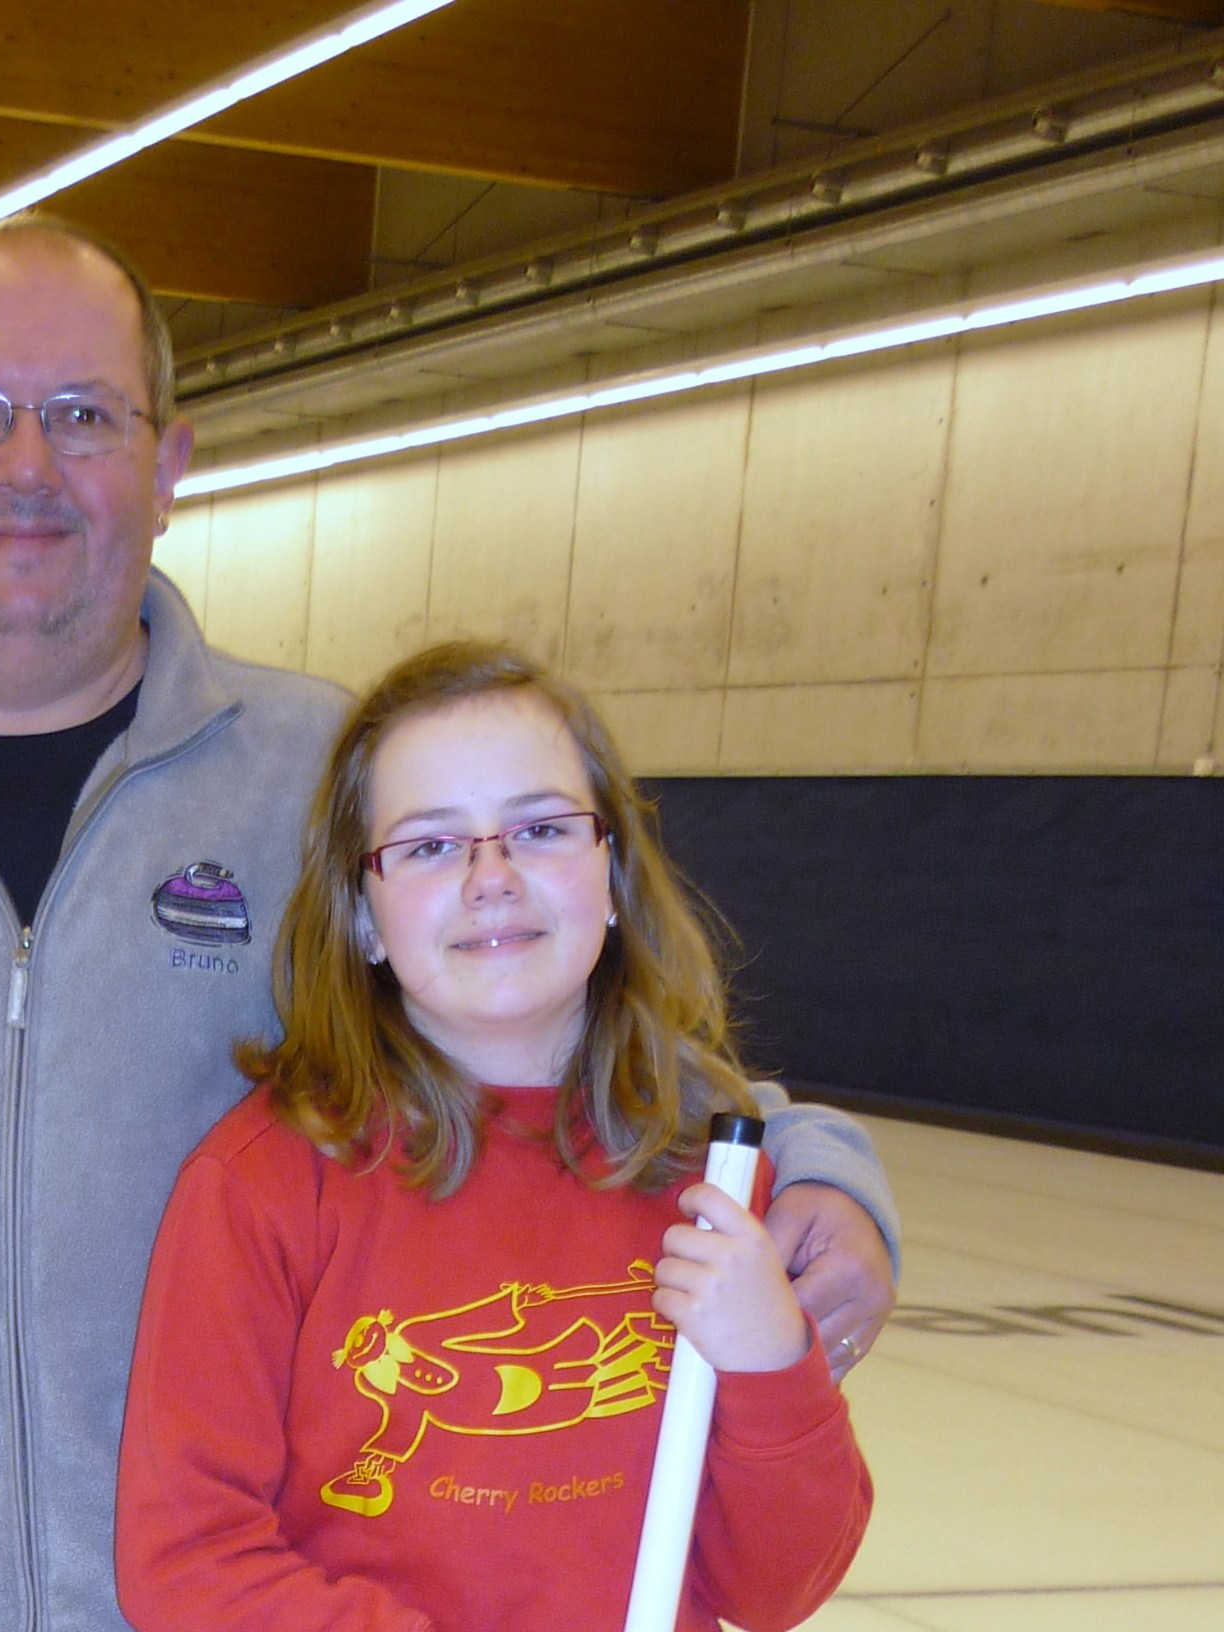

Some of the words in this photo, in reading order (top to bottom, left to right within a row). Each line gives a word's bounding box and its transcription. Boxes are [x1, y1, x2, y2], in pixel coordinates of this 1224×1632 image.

[171, 948, 239, 974] Bruno
[429, 1476, 519, 1514] Cherry
[529, 1473, 625, 1504] Rockers
